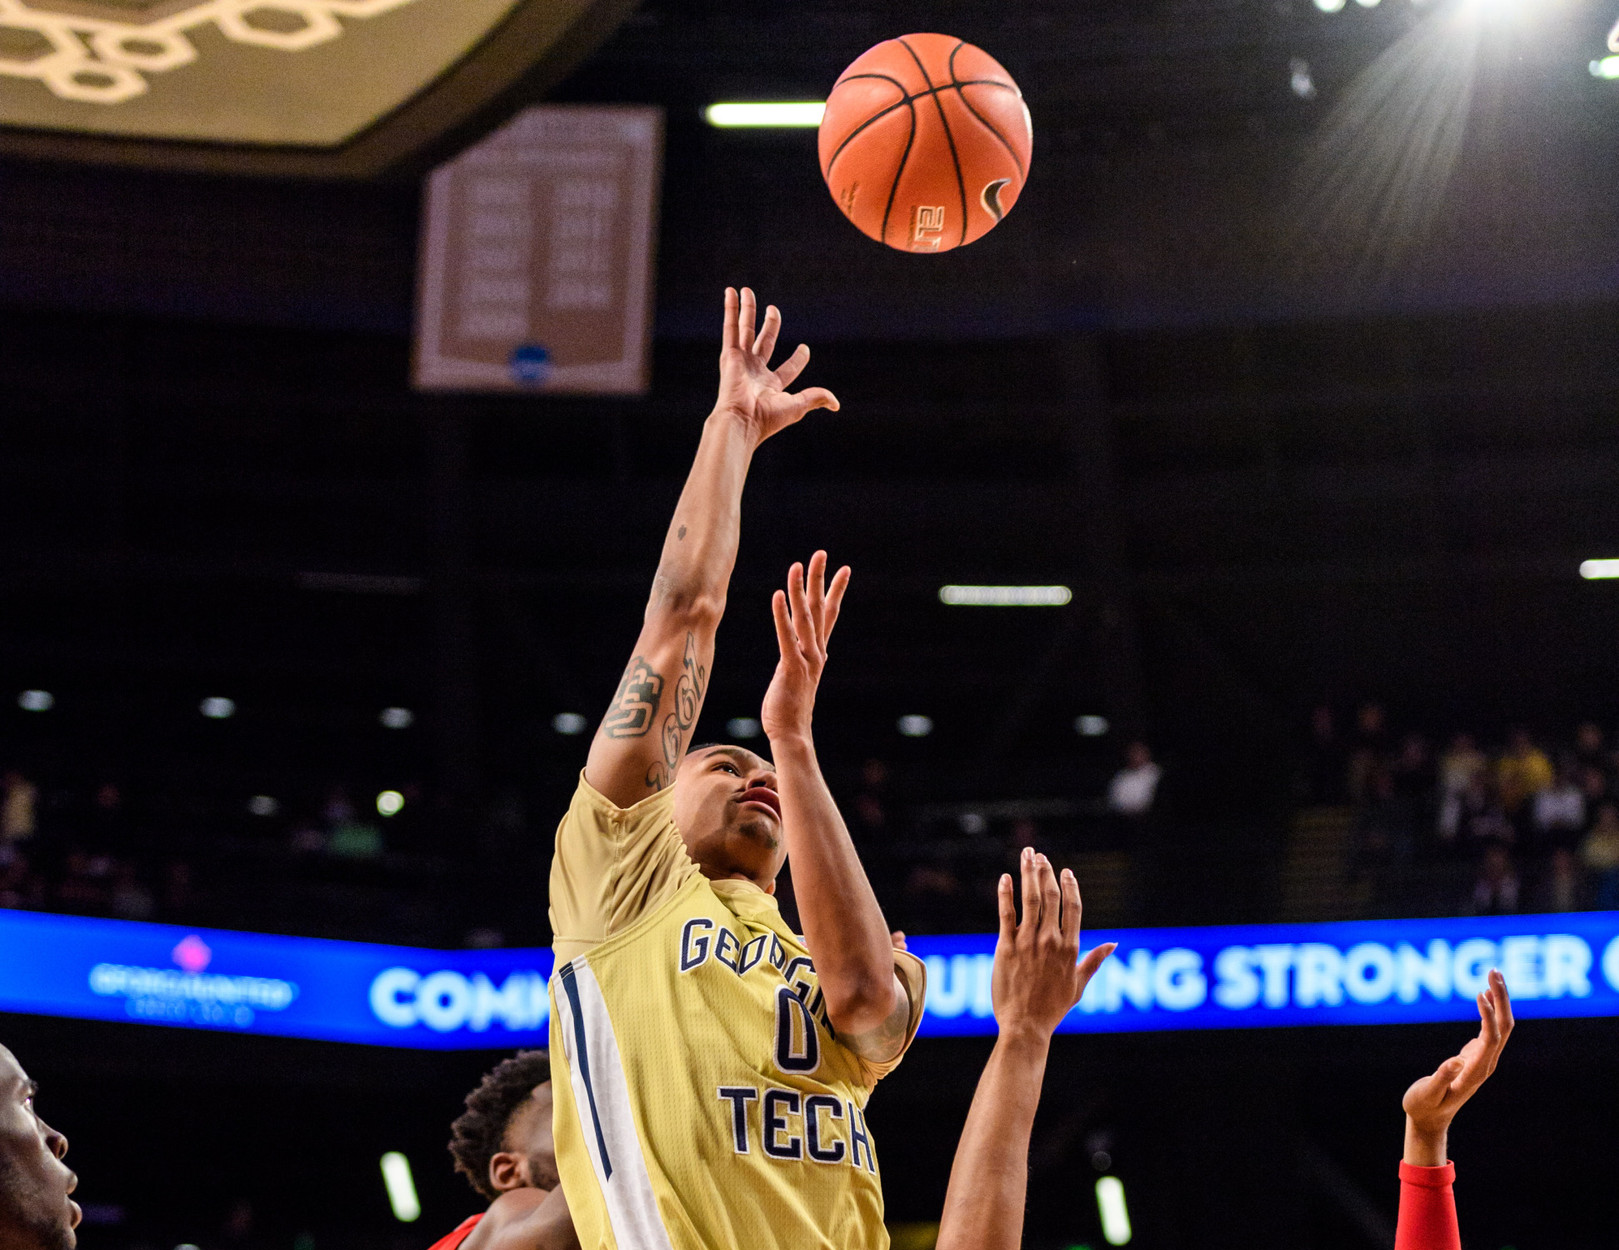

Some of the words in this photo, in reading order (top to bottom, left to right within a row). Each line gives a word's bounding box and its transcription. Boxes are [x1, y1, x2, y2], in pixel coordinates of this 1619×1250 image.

[1213, 934, 1593, 1010] STRONGER
[773, 984, 820, 1075] 0
[716, 1086, 876, 1176] TECH
